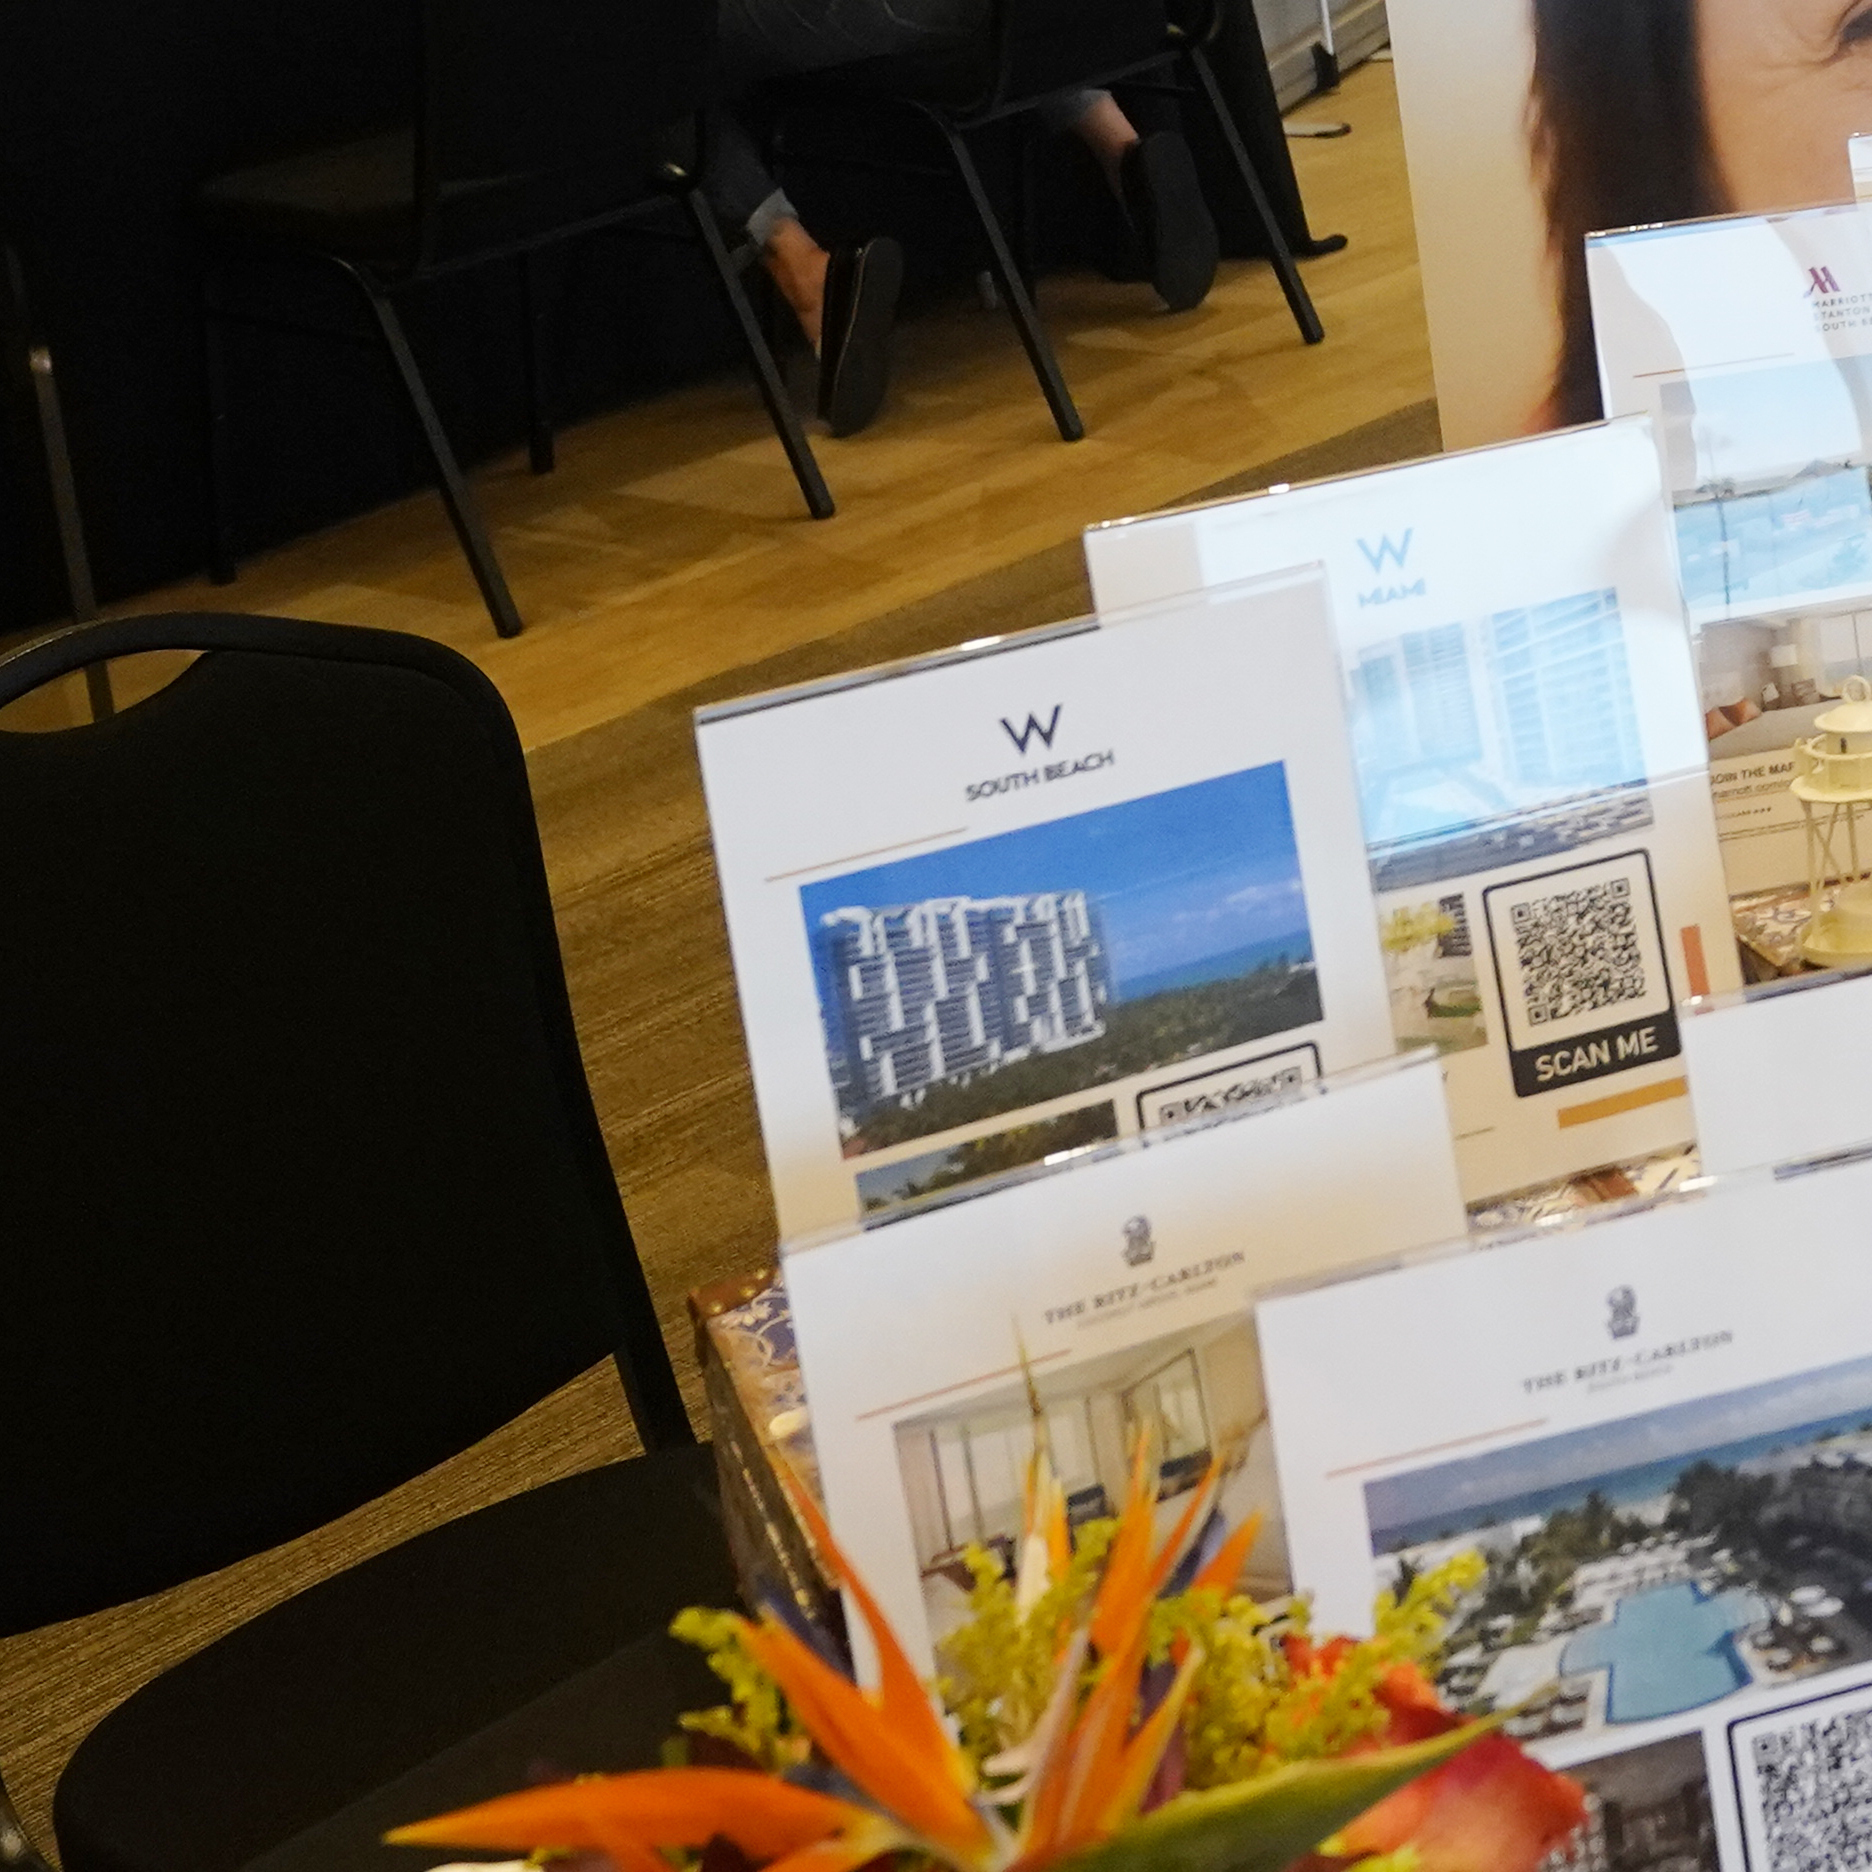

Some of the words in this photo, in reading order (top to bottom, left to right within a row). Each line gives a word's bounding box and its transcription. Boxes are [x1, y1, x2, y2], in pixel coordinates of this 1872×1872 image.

[999, 703, 1062, 754] W
[965, 769, 1040, 801] SOUTH
[1043, 749, 1115, 781] BEACH
[1535, 1039, 1612, 1082] SCAN
[1616, 1026, 1659, 1061] ME
